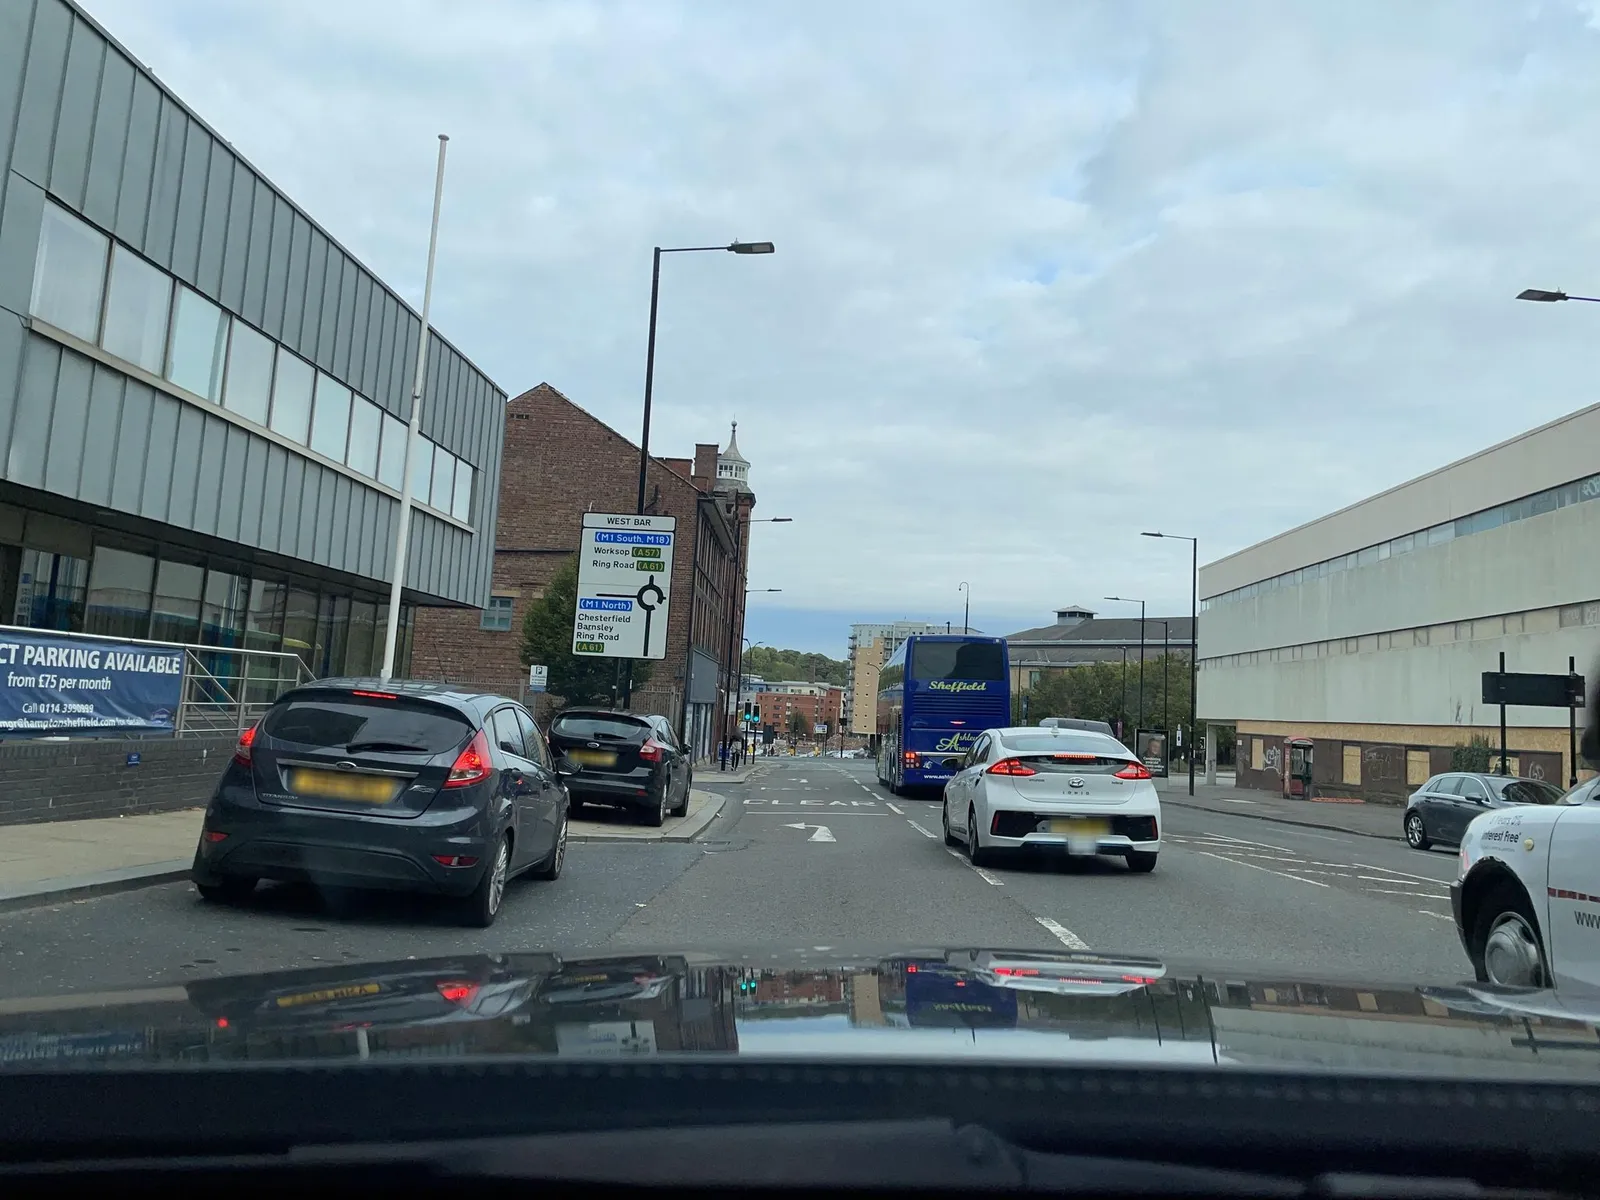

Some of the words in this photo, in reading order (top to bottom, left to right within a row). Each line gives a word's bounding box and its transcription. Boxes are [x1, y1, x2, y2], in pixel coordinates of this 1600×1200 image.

[607, 518, 631, 526] WEST
[596, 533, 614, 542] (M1
[646, 535, 670, 544] M18)
[594, 547, 630, 556] Worksop
[592, 560, 611, 569] Ring
[580, 599, 599, 608] (M1
[601, 601, 632, 610] North)
[578, 614, 631, 623] Chesterfield
[577, 623, 614, 632] Barnsley
[576, 632, 595, 641] Ring
[598, 633, 619, 641] Road
[23, 646, 100, 669] PARKING
[104, 652, 181, 674] AVAILABLE
[8, 672, 35, 688] from
[38, 674, 57, 688] £75
[59, 676, 77, 692] per
[79, 676, 111, 690] month
[928, 680, 986, 692] Sheffield
[22, 703, 38, 713] Call
[39, 703, 60, 713] 0114
